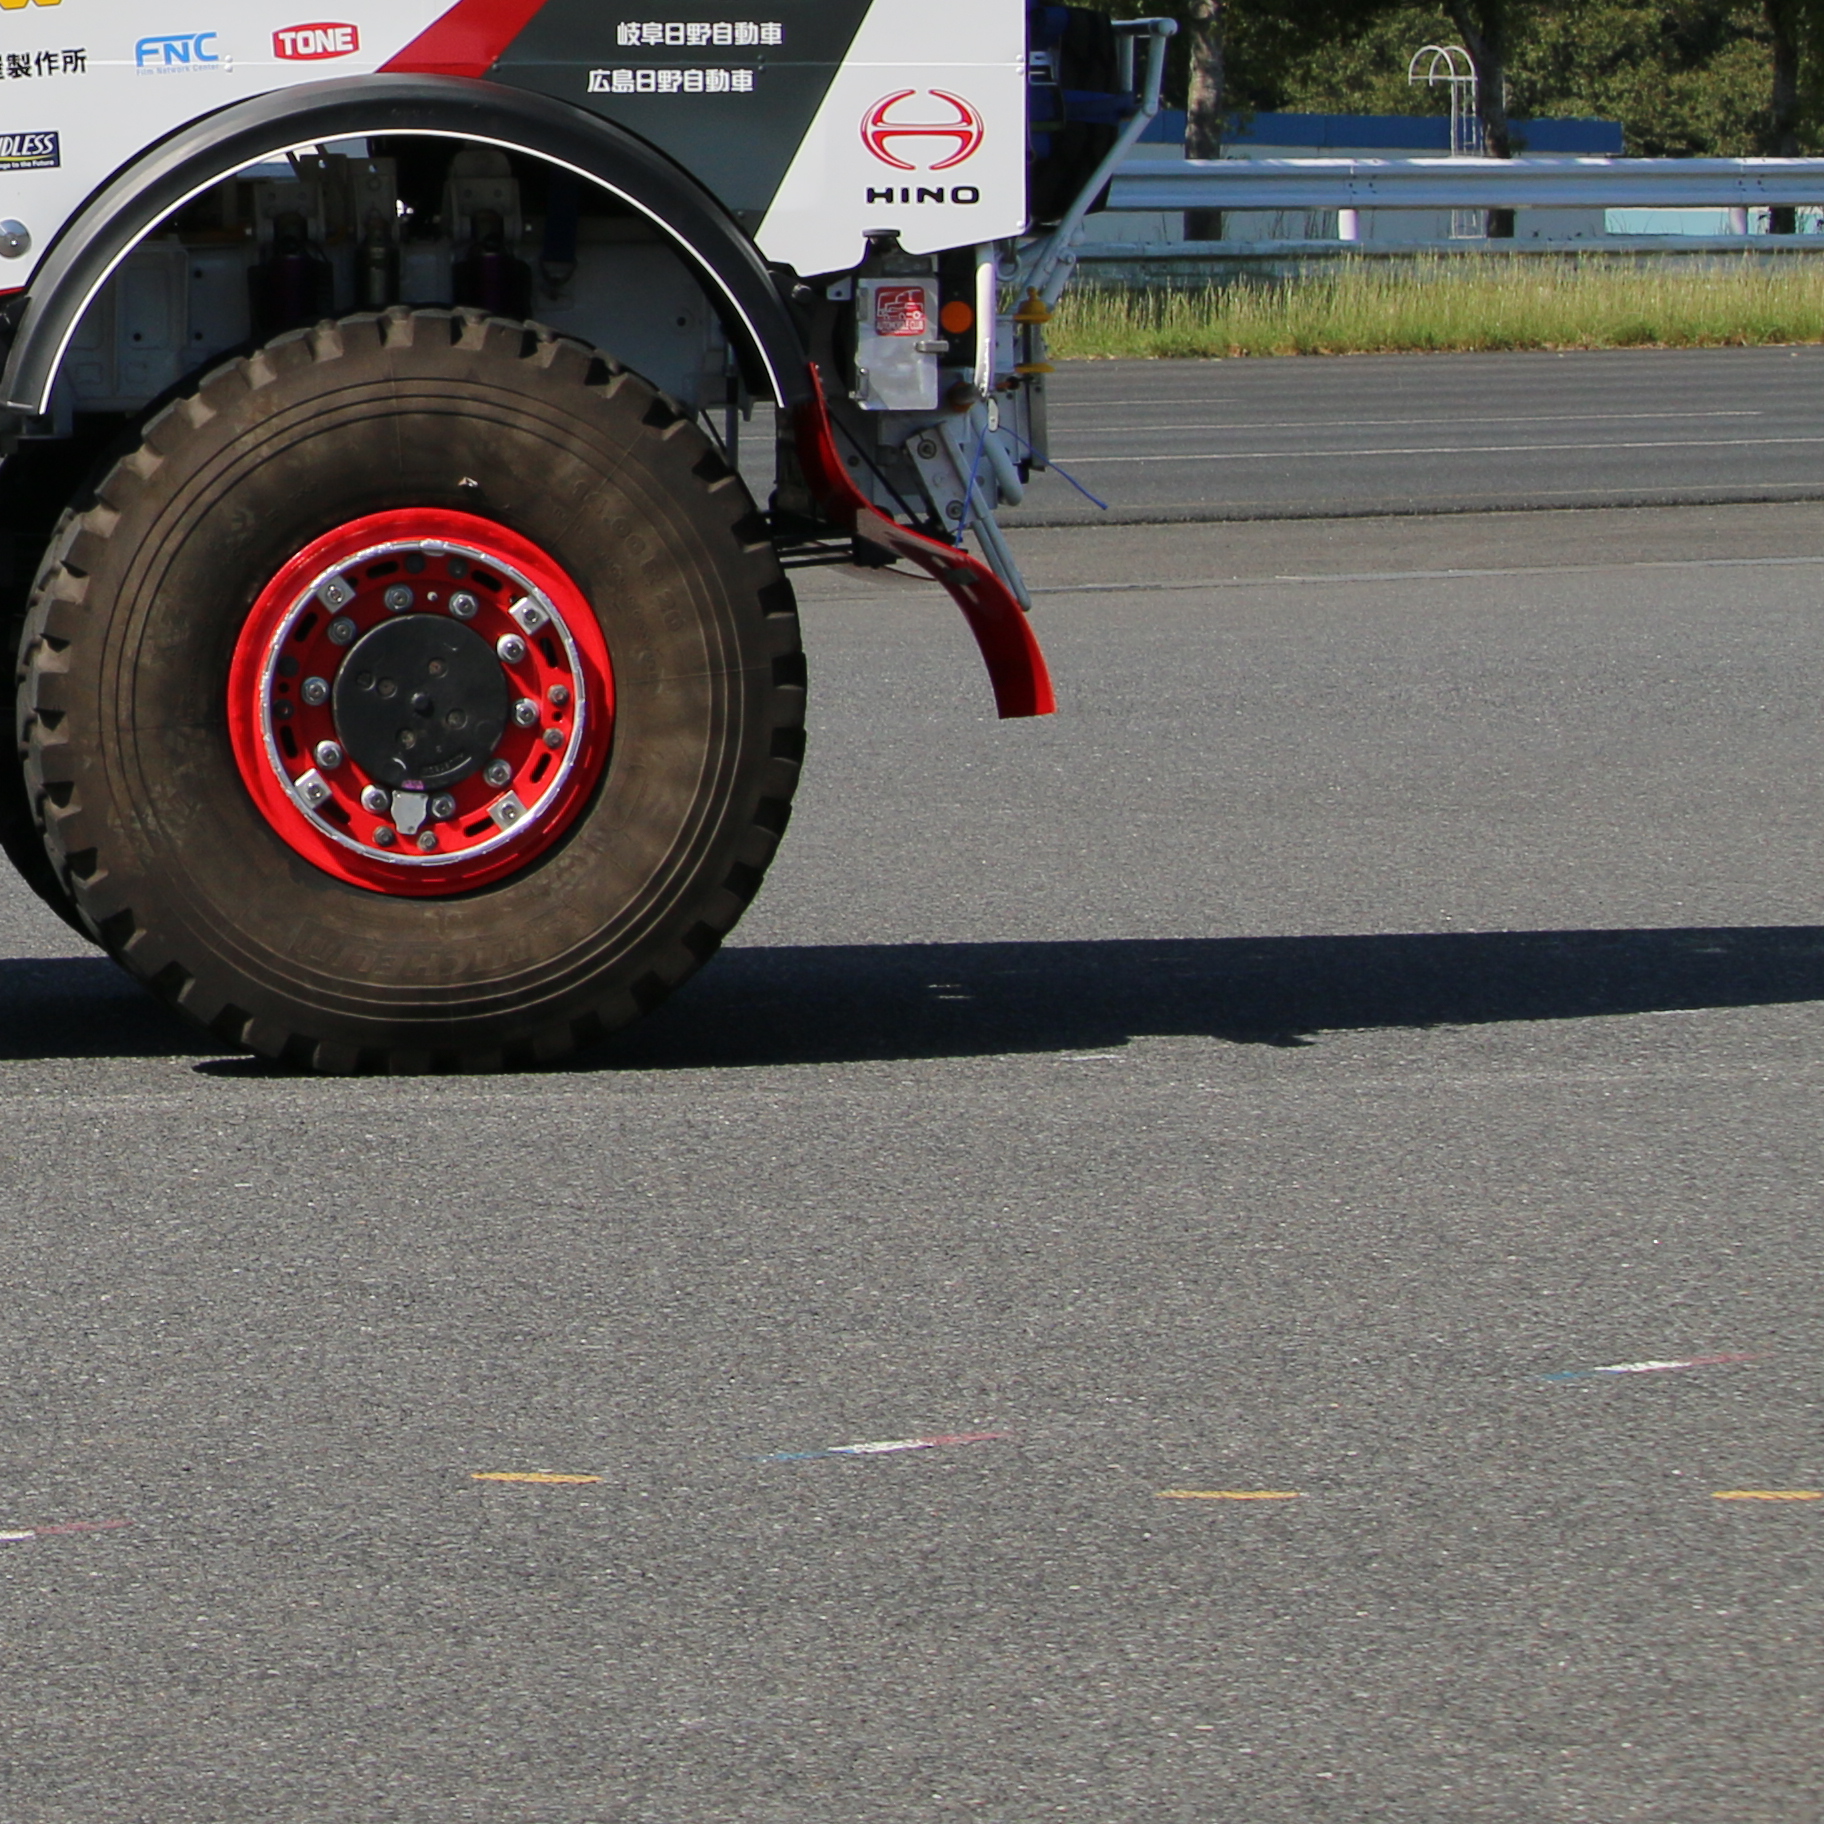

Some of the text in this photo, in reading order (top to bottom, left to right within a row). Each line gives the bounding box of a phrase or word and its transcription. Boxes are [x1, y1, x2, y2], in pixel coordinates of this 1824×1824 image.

[279, 27, 353, 55] TONE
[617, 22, 782, 45] 岐阜日野自動車
[135, 32, 219, 67] FNC
[588, 69, 753, 93] 広島日野自動車
[867, 186, 979, 204] HINO
